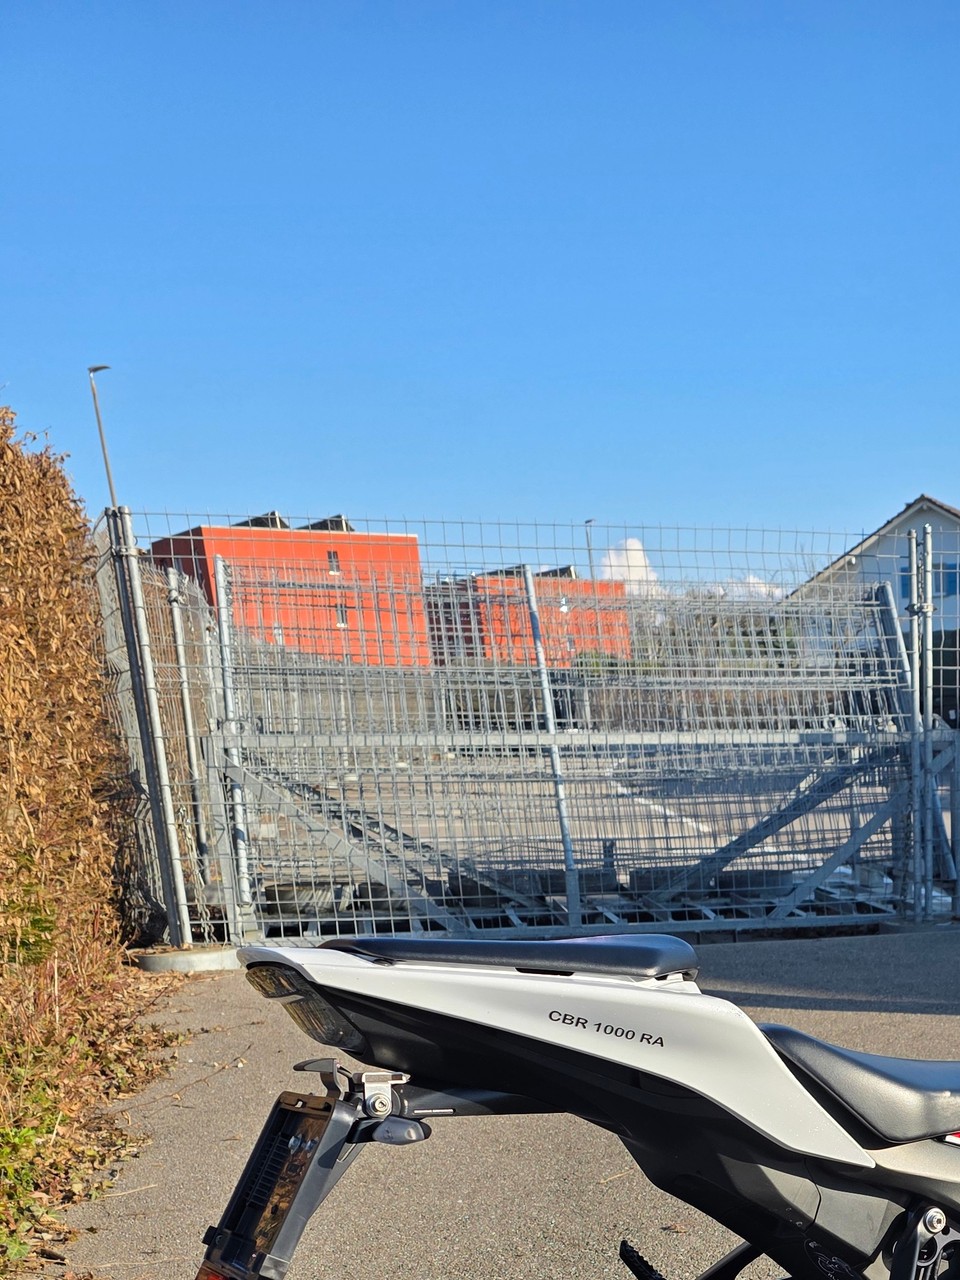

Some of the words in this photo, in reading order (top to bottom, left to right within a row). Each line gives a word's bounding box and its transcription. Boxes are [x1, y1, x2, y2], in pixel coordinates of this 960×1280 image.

[548, 1010, 588, 1029] CBR
[593, 1022, 636, 1040] 1000
[639, 1033, 664, 1047] RA
